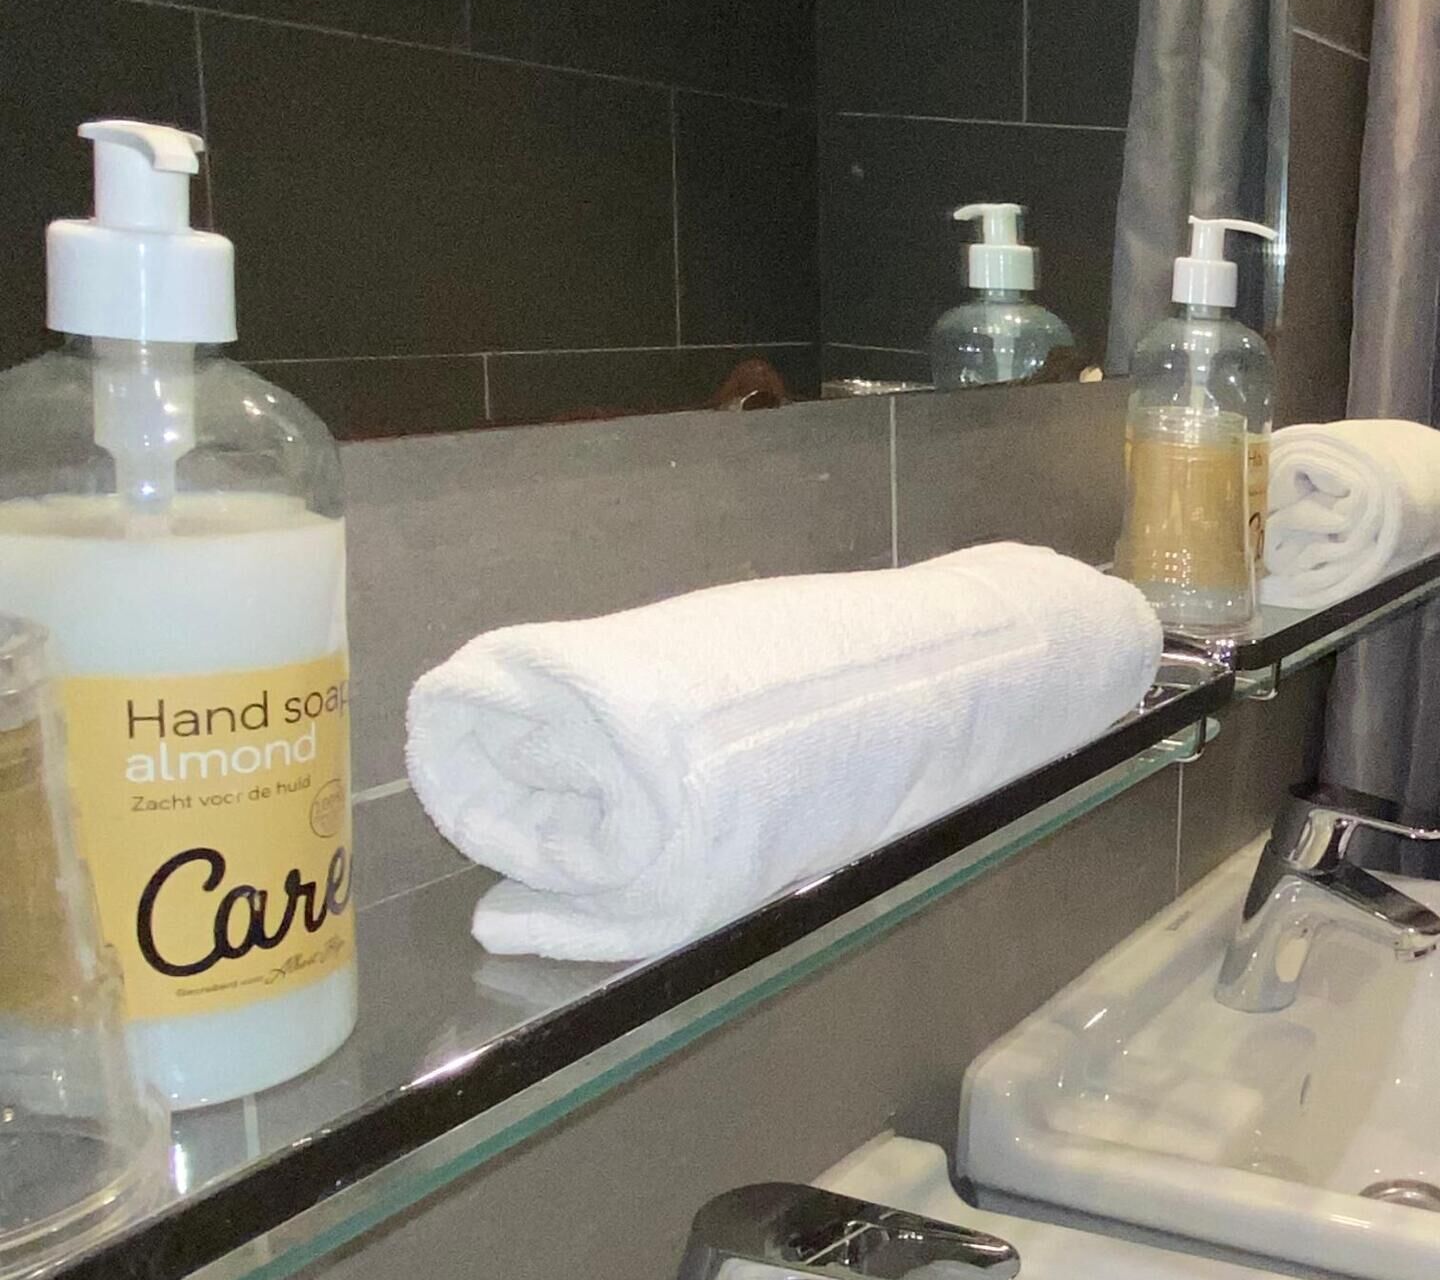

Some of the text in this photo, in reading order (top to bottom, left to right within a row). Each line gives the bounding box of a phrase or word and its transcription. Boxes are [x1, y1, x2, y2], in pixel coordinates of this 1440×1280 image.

[127, 689, 269, 740] Hand
[125, 722, 316, 783] almond
[130, 795, 192, 812] Zacht
[248, 785, 272, 802] de
[275, 775, 312, 795] huid
[136, 847, 350, 977] Care
